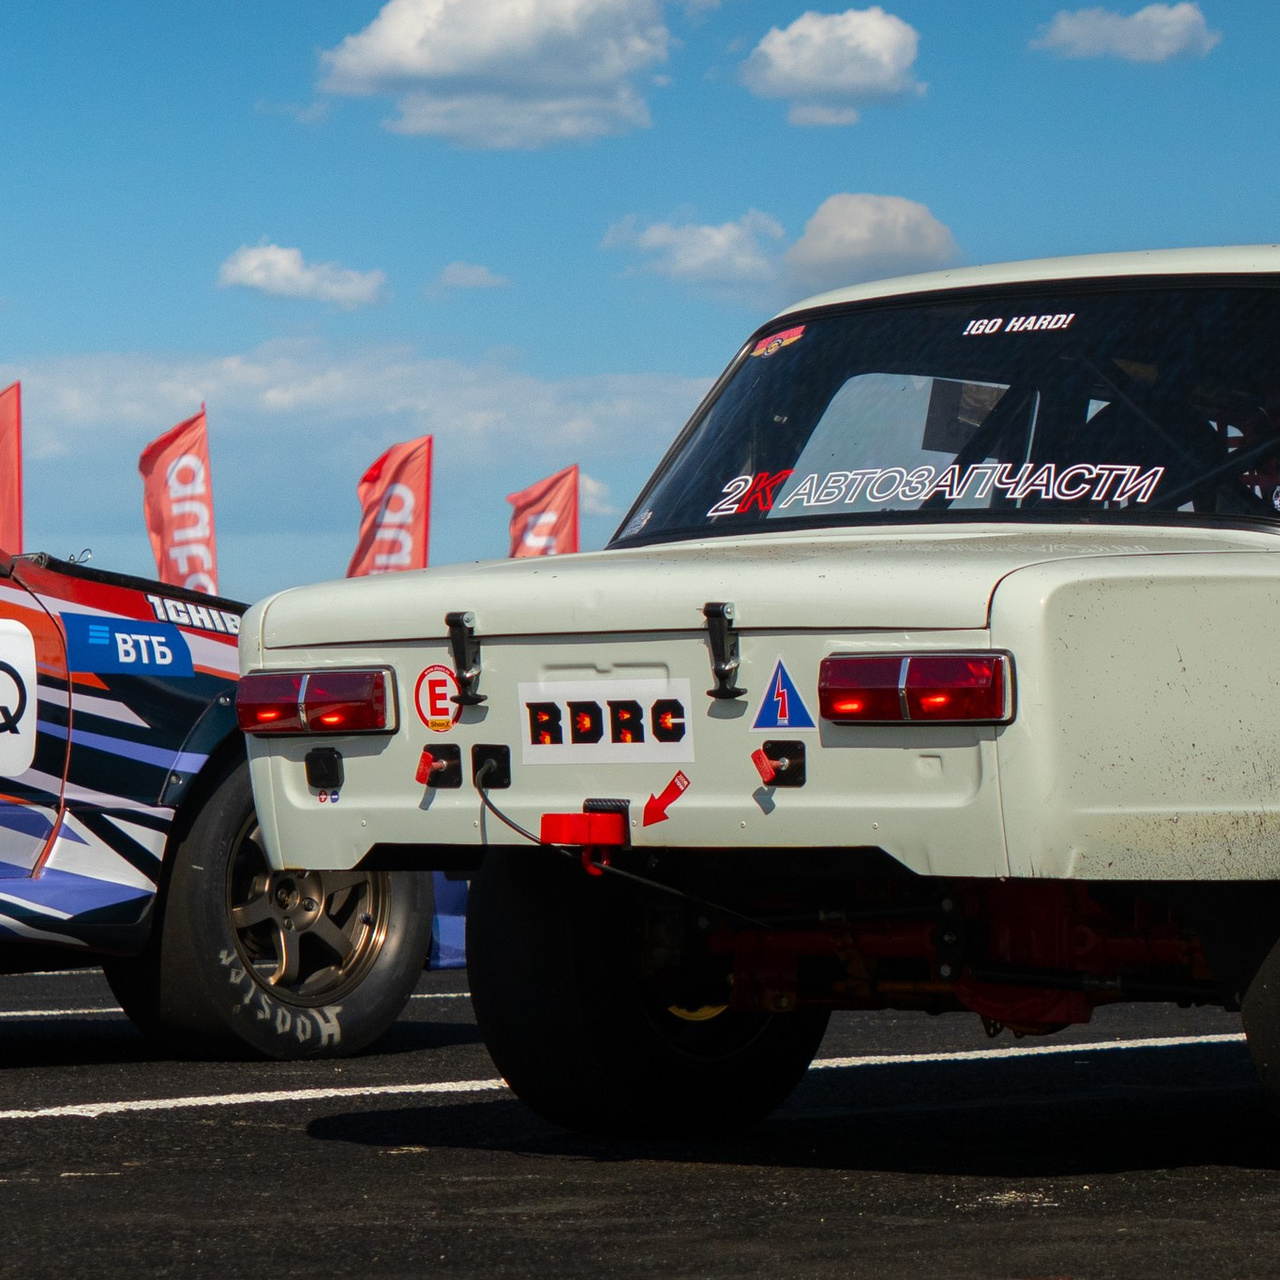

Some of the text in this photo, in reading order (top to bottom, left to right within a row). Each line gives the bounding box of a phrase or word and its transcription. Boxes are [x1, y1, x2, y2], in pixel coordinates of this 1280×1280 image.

[963, 313, 1075, 336] !GO HARD!
[779, 463, 1165, 509] АВТОЗАПЧАСТИ
[114, 632, 173, 666] ВТБ
[428, 679, 450, 717] E
[525, 699, 686, 745] RDRC
